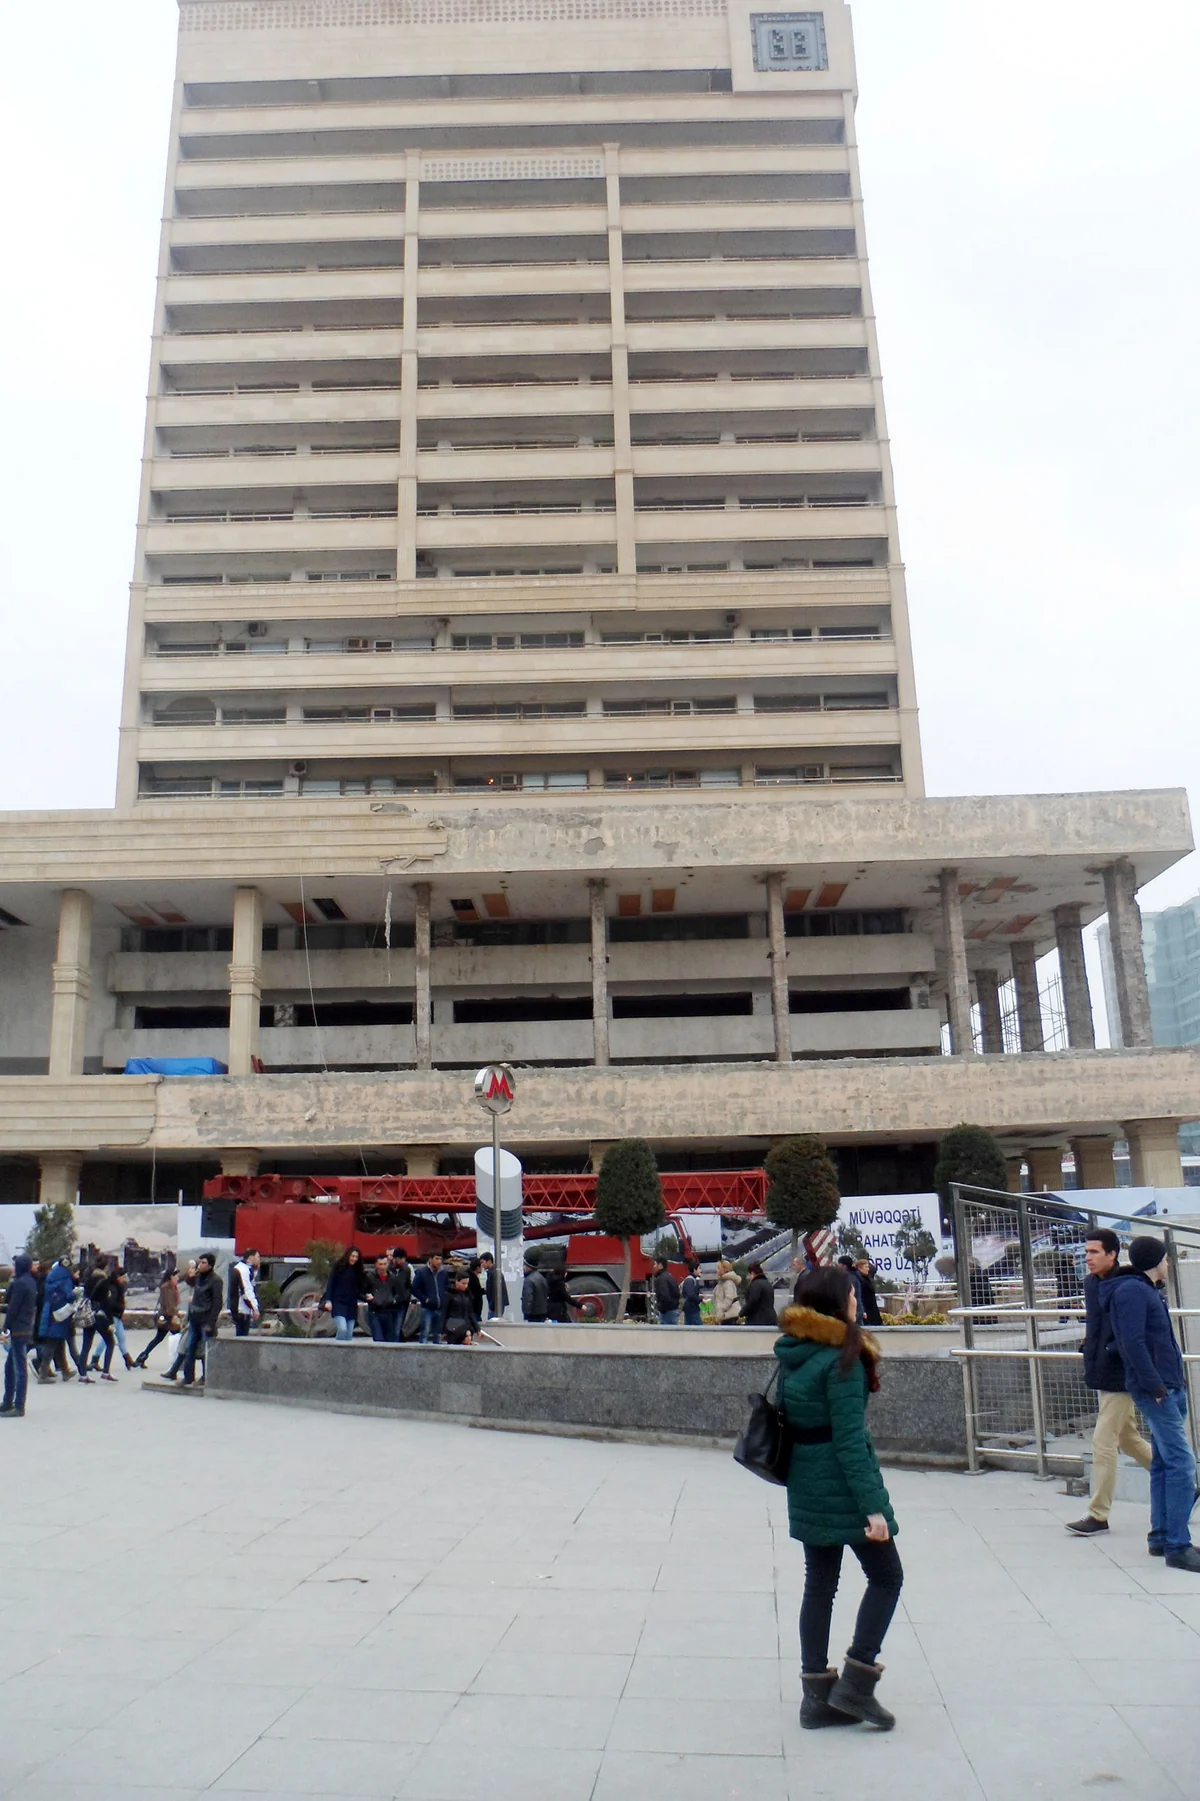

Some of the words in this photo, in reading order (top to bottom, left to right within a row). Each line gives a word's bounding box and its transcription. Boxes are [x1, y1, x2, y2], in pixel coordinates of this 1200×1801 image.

[486, 1071, 514, 1100] M
[849, 1206, 921, 1225] MÜVƏQQƏTİ
[863, 1255, 892, 1271] ÖRƏ
